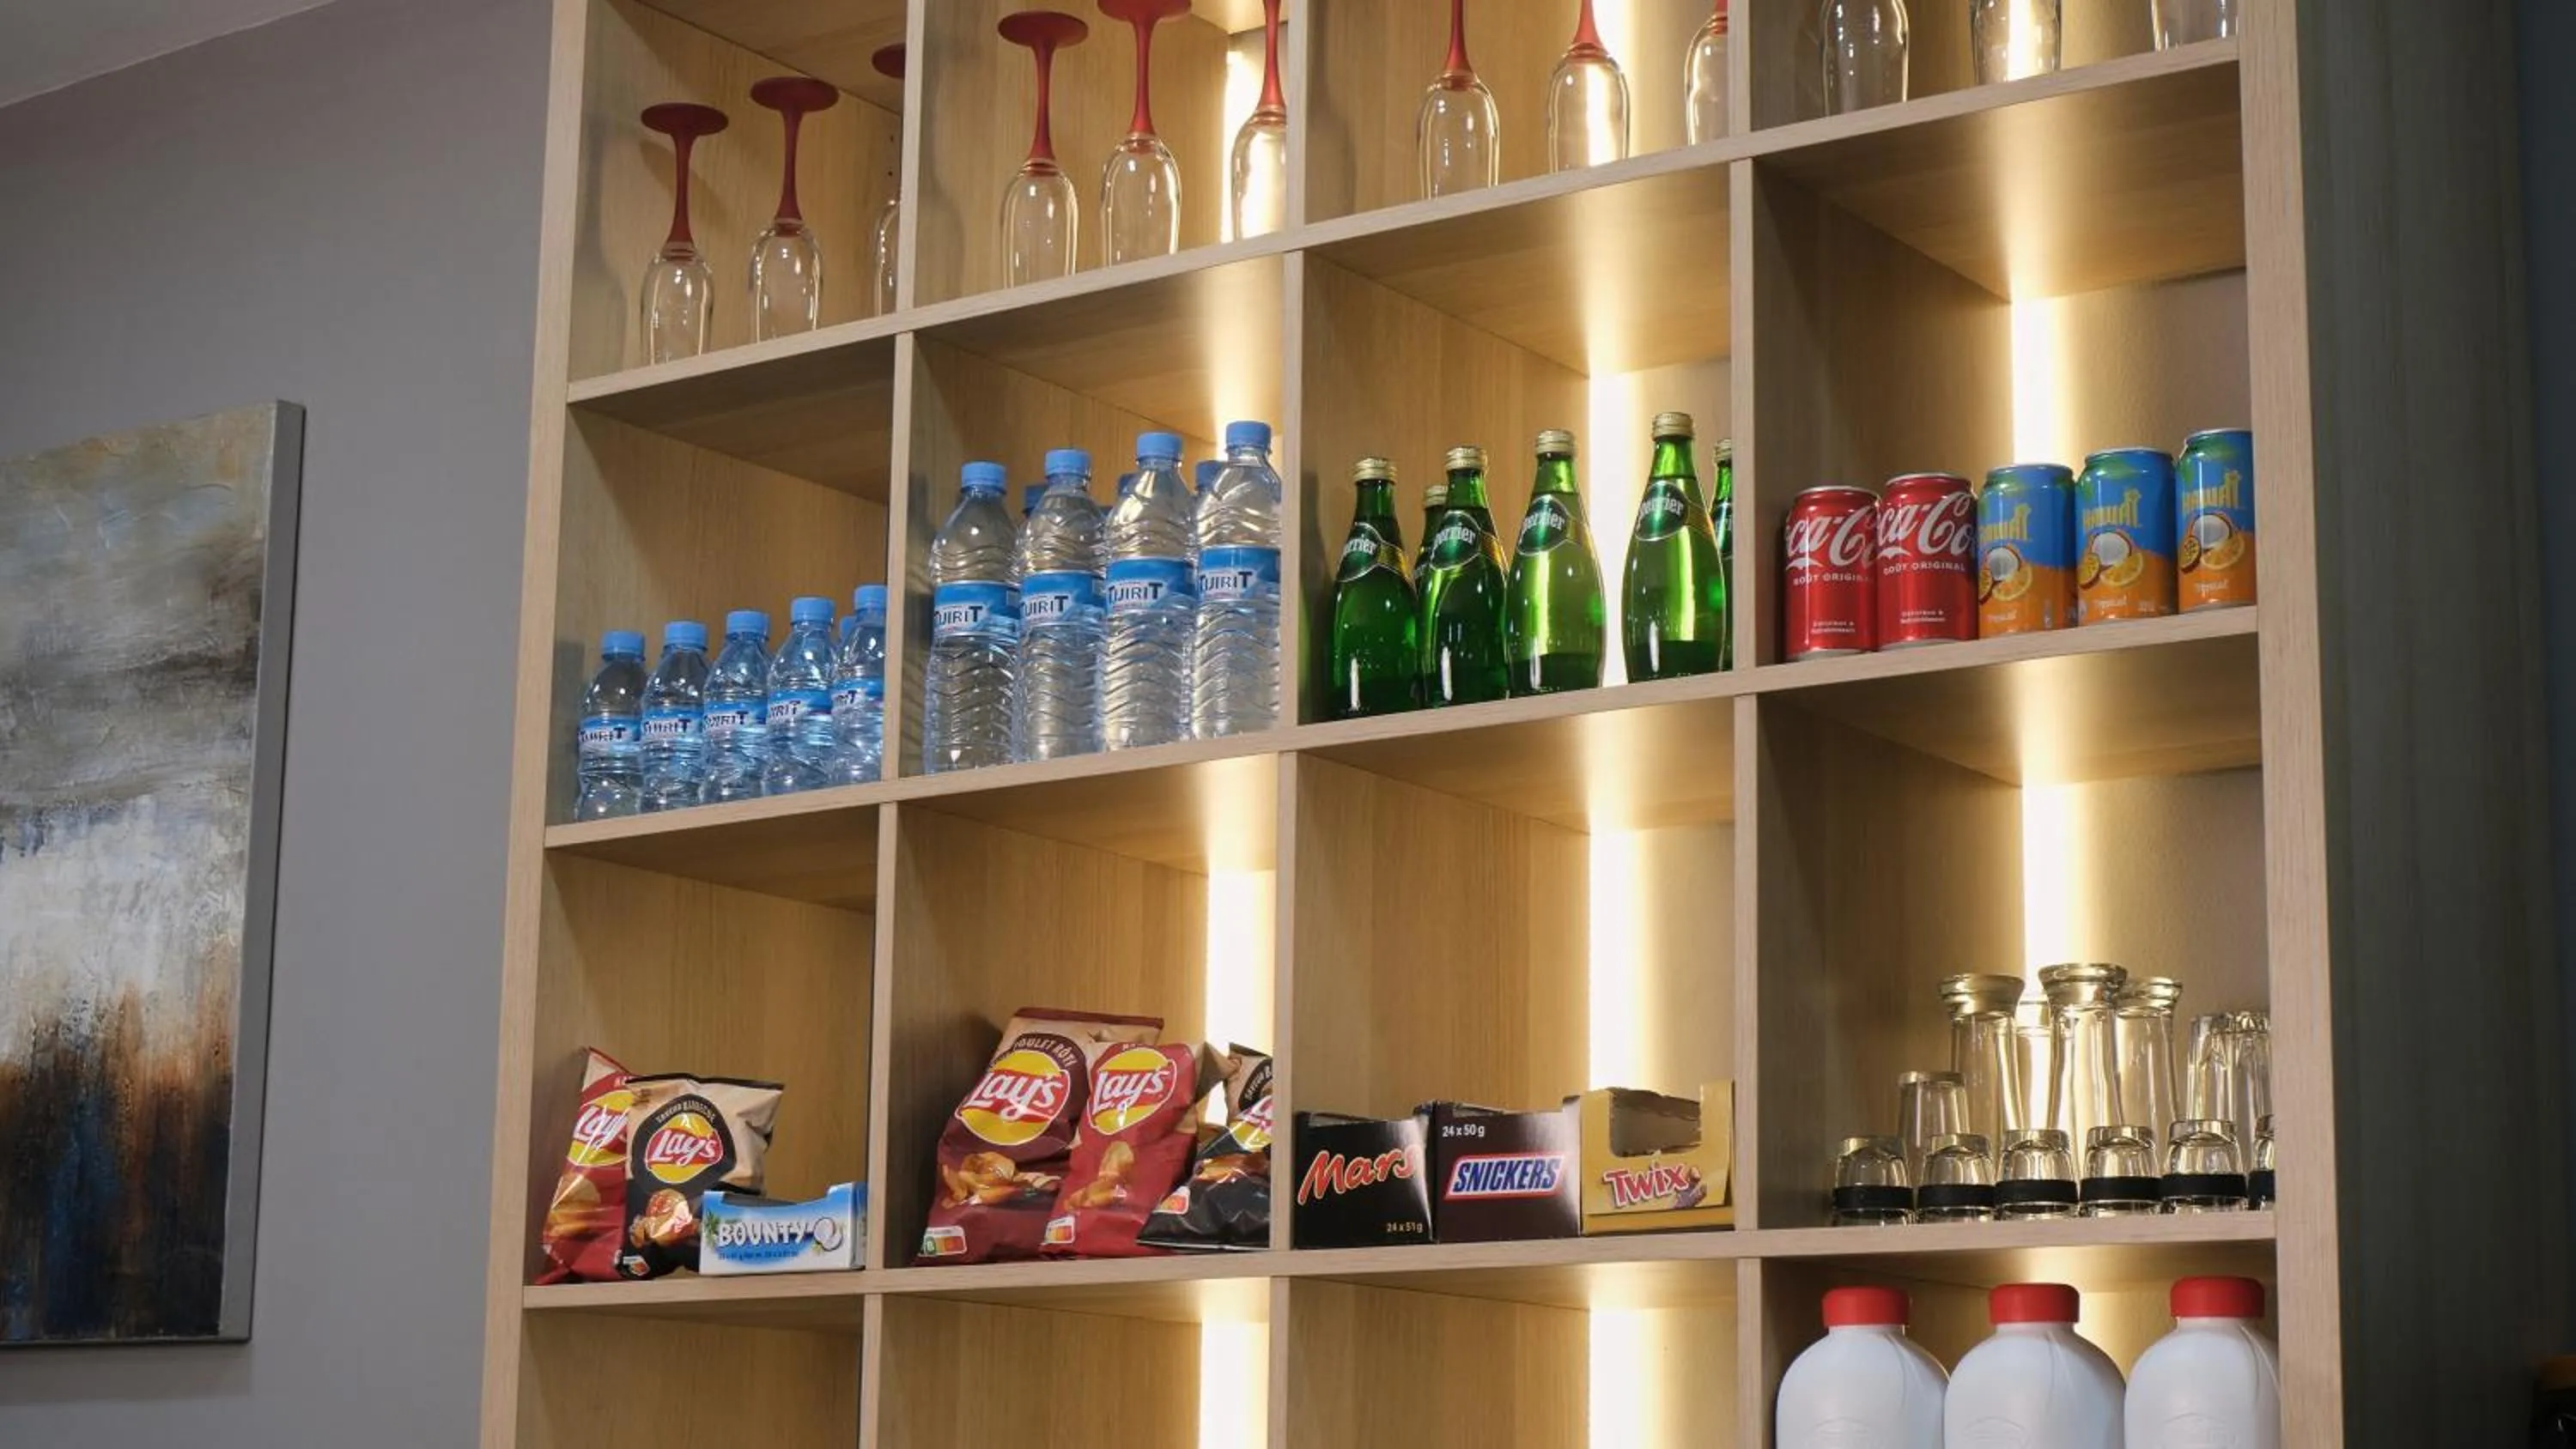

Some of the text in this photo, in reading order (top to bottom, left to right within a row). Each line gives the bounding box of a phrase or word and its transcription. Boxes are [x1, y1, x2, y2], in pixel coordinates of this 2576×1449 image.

[1875, 492, 1974, 555] ca-Co
[1342, 534, 1377, 556] rrier
[1823, 573, 1868, 582] ORIGIN
[963, 1071, 1063, 1122] Lay's
[1091, 1065, 1170, 1116] Lay's
[573, 1105, 629, 1152] Lay
[1443, 1125, 1455, 1137] 24
[647, 1130, 716, 1167] Lay's
[1297, 1145, 1423, 1206] Mars
[1453, 1159, 1560, 1192] SNICKERS
[718, 1221, 815, 1247] BOUNTY
